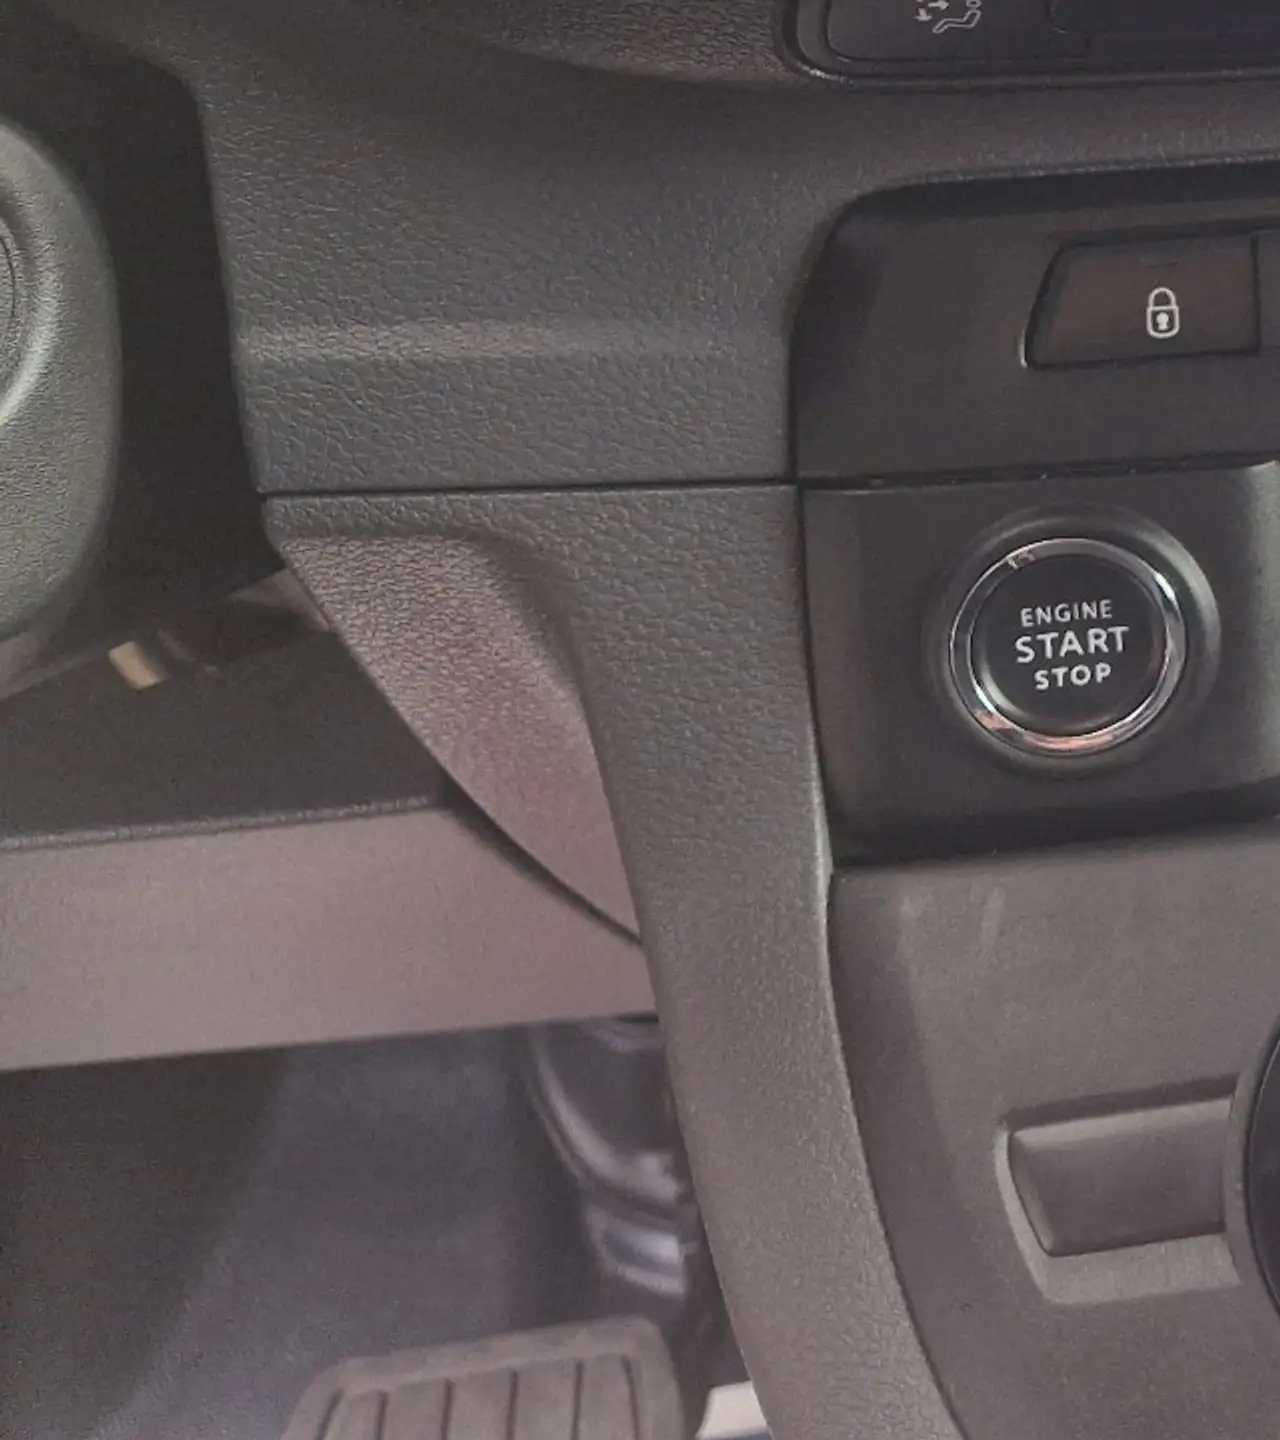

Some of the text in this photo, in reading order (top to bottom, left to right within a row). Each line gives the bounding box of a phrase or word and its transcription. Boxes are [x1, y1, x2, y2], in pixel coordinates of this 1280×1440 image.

[1020, 599, 1113, 628] ENGINE
[1015, 626, 1130, 663] START
[1034, 662, 1112, 690] STOP
